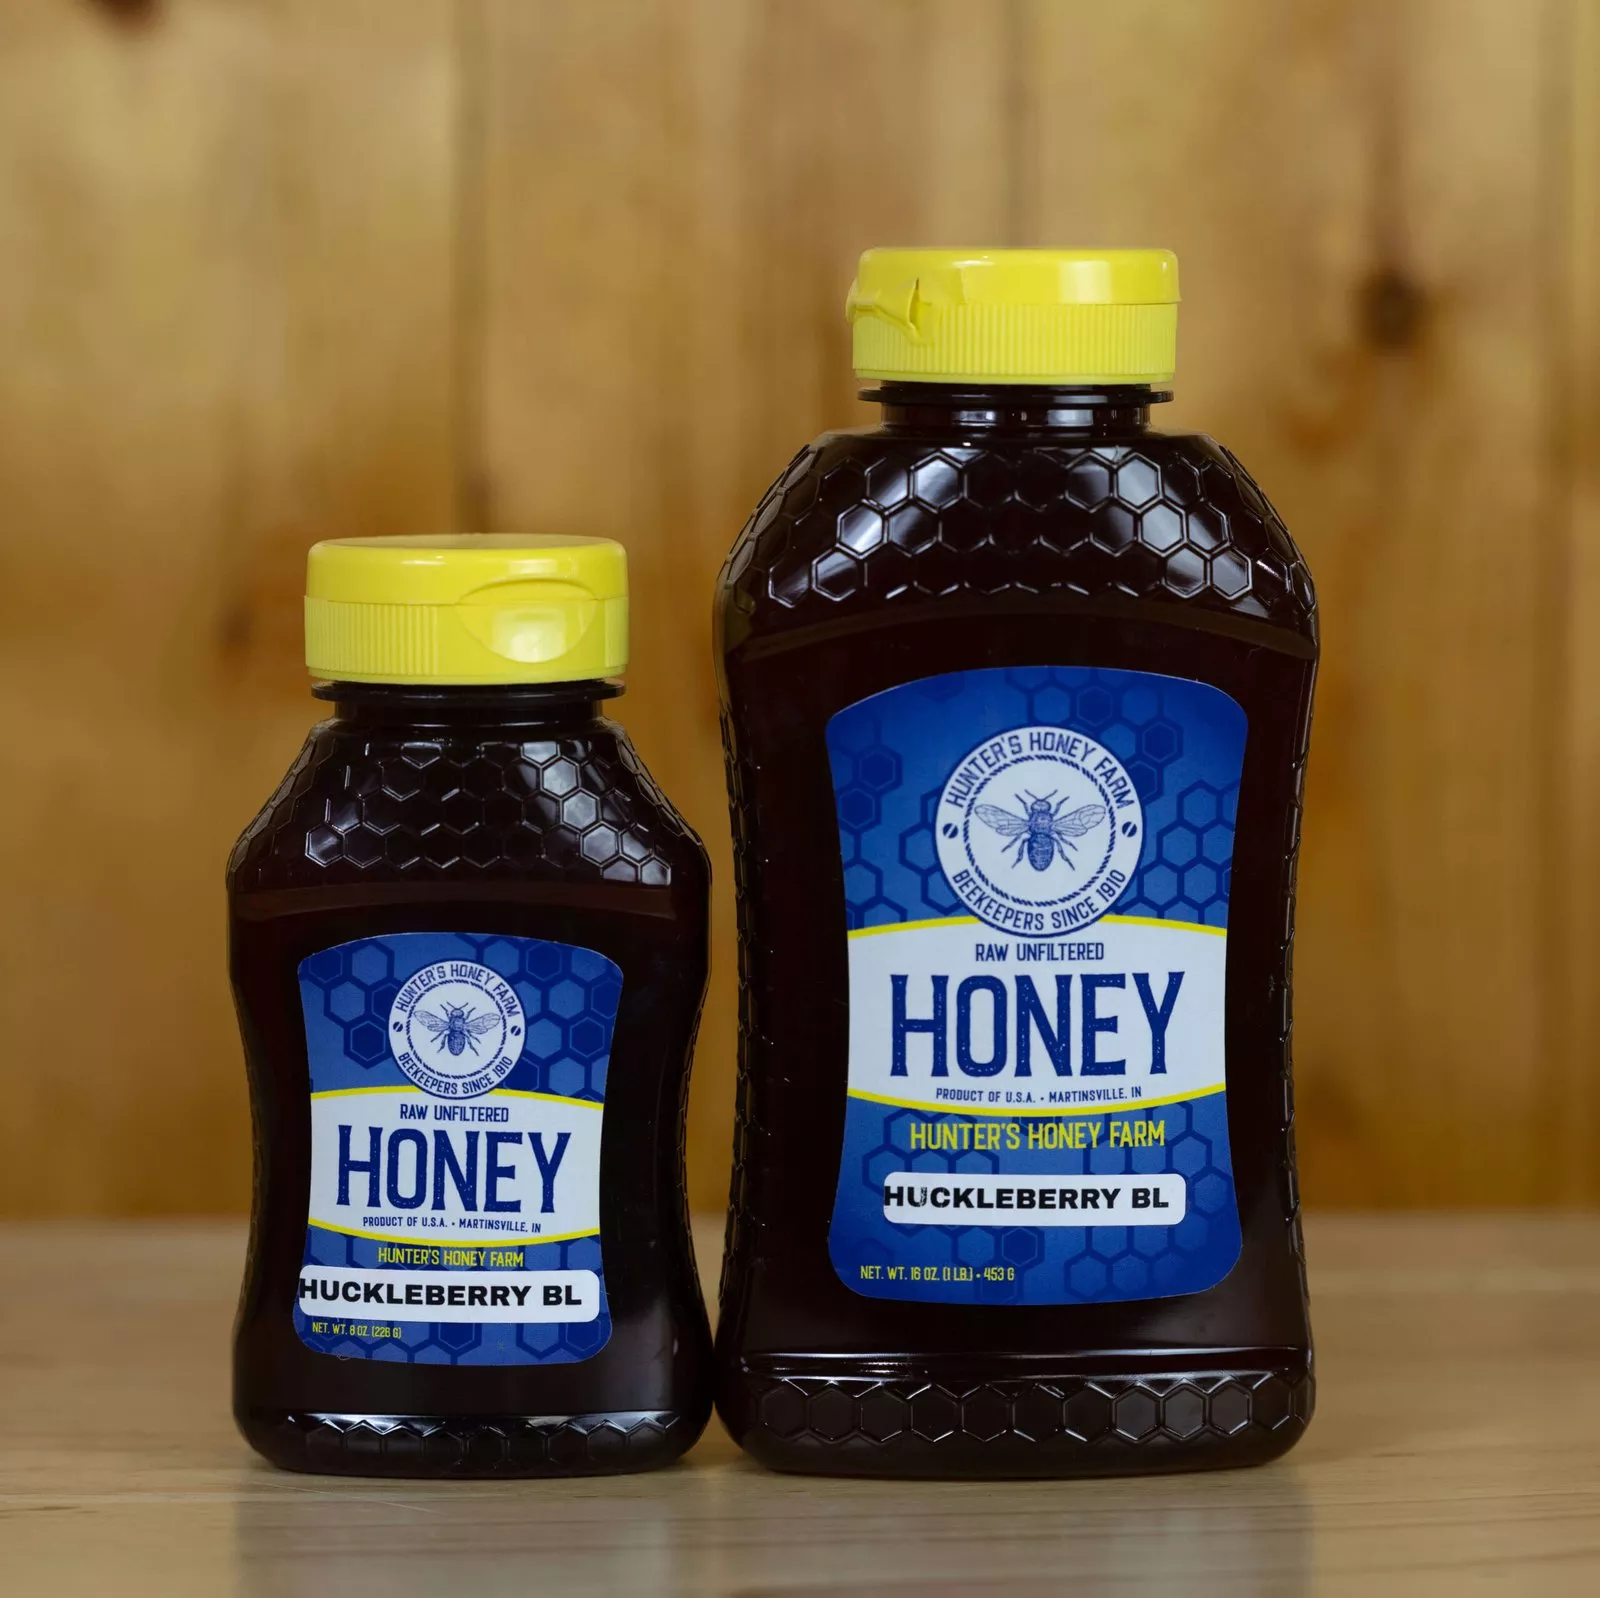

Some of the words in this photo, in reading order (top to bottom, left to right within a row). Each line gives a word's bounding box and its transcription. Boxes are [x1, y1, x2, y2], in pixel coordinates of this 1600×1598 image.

[945, 734, 1023, 808] HUNTER'S
[1029, 731, 1097, 762] HONEY
[1093, 756, 1135, 810] FARM
[952, 868, 1045, 931] BEEKEEPERS
[1050, 896, 1099, 930] SINCE
[1096, 868, 1127, 903] 1910
[975, 943, 1009, 962] RAW
[1016, 942, 1105, 962] UNFILTERED
[395, 965, 446, 1013] HUNTER'S
[450, 963, 495, 986] HONEY
[492, 982, 521, 1018] FARM
[890, 971, 1185, 1078] HONEY
[397, 1051, 458, 1095] BEEKEEPERS
[461, 1073, 495, 1097] SINCE
[492, 1055, 513, 1079] 1910
[935, 1087, 984, 1102] PRODUCT
[988, 1089, 1002, 1103] OF
[1005, 1090, 1036, 1104] U.S.A.
[1131, 1085, 1142, 1098] IN
[399, 1103, 429, 1120] RAW
[433, 1105, 509, 1123] UNFILTERED
[910, 1122, 1021, 1151] HUNTER'S
[1028, 1121, 1102, 1150] HONEY
[1109, 1119, 1165, 1148] FARM
[336, 1124, 572, 1214] HONEY
[884, 1184, 1122, 1210] HUCKLEBERRY
[1131, 1187, 1169, 1210] BL
[362, 1216, 403, 1227] PRODUCT
[407, 1216, 418, 1227] OF
[421, 1217, 448, 1228] U.S.A.
[531, 1222, 541, 1234] IN
[377, 1247, 440, 1265] HUNTER'S
[443, 1249, 487, 1266] HONEY
[490, 1251, 524, 1268] FARM
[860, 1265, 884, 1280] NET.
[887, 1266, 908, 1281] WT.
[910, 1266, 921, 1281] 16
[923, 1266, 940, 1281] OZ.
[983, 1266, 1004, 1281] 453
[1007, 1267, 1015, 1281] G
[299, 1277, 532, 1306] HUCKLEBERRY
[542, 1284, 582, 1306] BL
[312, 1321, 330, 1334] NET.
[332, 1323, 348, 1335] WT.
[349, 1324, 355, 1336] 8
